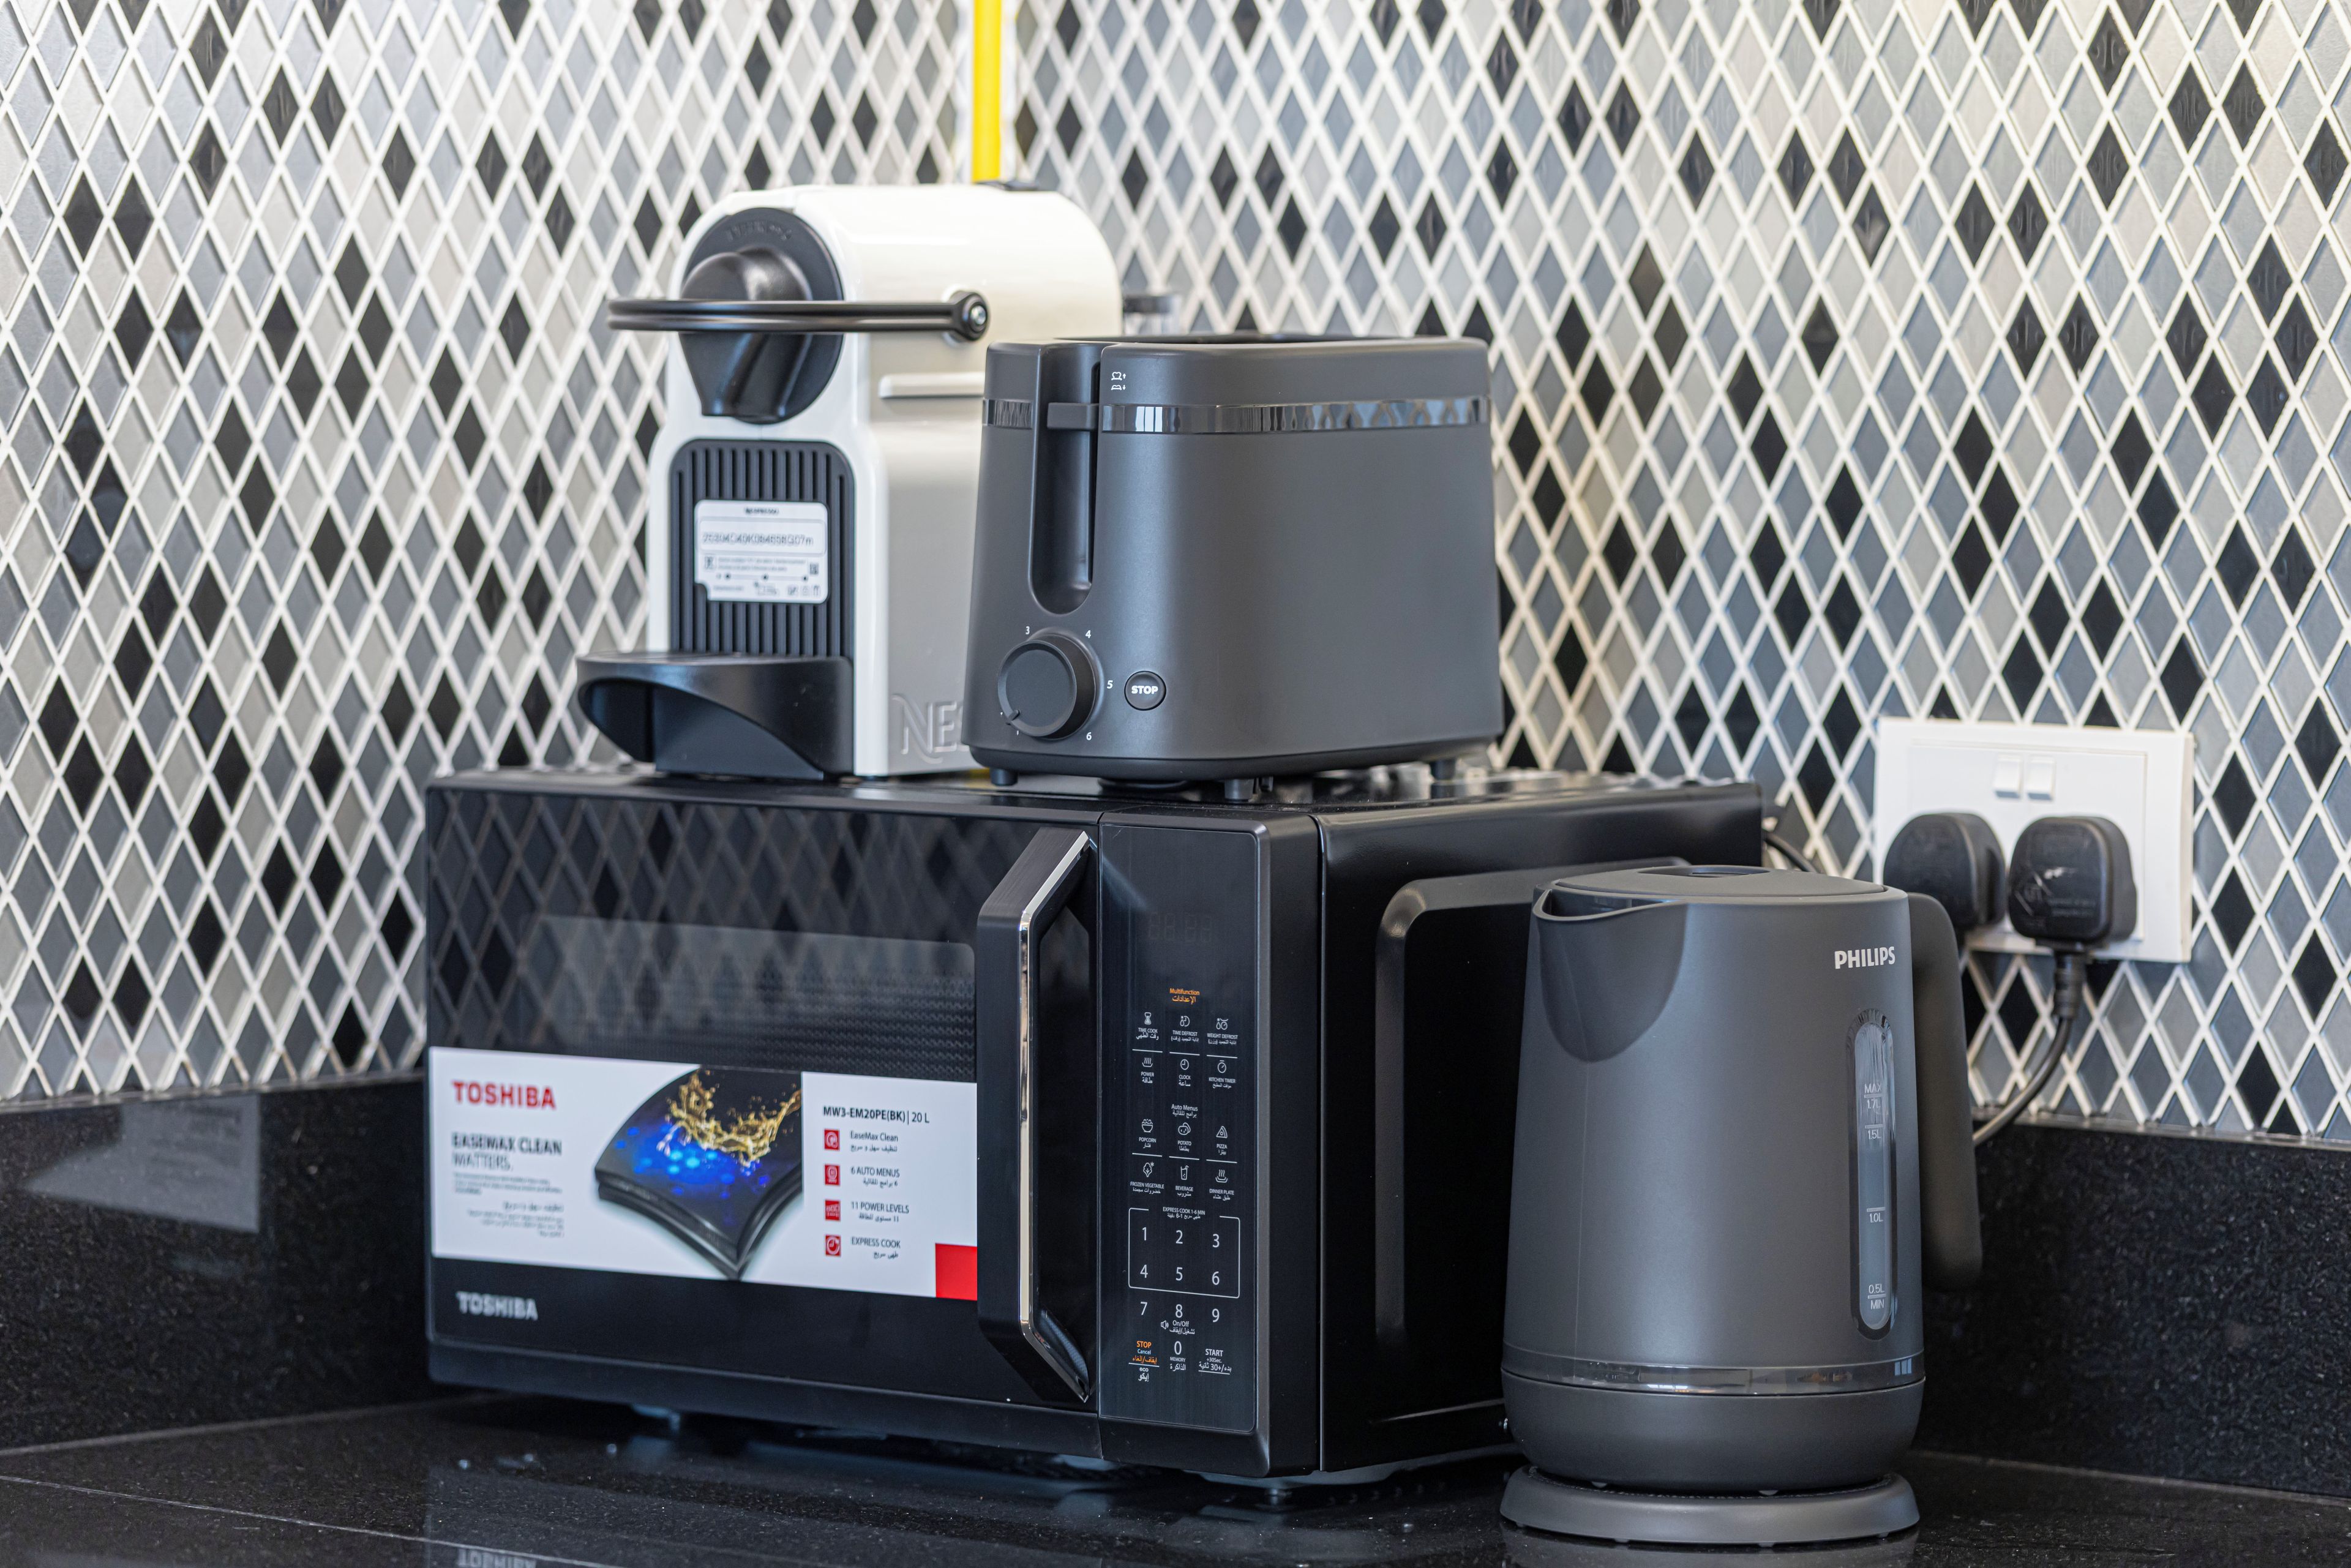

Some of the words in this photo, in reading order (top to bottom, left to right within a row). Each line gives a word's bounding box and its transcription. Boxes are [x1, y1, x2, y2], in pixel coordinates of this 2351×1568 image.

[1107, 680, 1113, 689] 5
[1834, 946, 1895, 969] PHILIPS
[1172, 996, 1196, 1004] الإعدادات
[1864, 1083, 1881, 1093] MAX
[452, 1081, 557, 1110] TOSHIBA
[1867, 1099, 1881, 1109] 1.7L
[912, 1111, 923, 1122] 20
[924, 1113, 929, 1123] L
[850, 1130, 878, 1141] EaseMax
[880, 1132, 898, 1142] Clean
[1868, 1130, 1881, 1139] 1.5L
[518, 1137, 563, 1155] CLEAN
[857, 1166, 875, 1176] AUTO
[876, 1168, 900, 1177] MENUS
[861, 1202, 884, 1212] POWER
[886, 1204, 910, 1214] LEVELS
[1869, 1213, 1883, 1223] 1.0L
[1142, 1227, 1147, 1241] 1
[1176, 1230, 1183, 1245] 2
[852, 1237, 879, 1247] EXPRESS
[881, 1239, 901, 1249] COOK
[1212, 1234, 1220, 1248] 3
[1140, 1264, 1148, 1278] 4
[1176, 1267, 1183, 1281] 5
[1212, 1271, 1220, 1285] 6
[1869, 1284, 1884, 1294] 0.5L
[456, 1291, 539, 1321] TOSHIBA
[1141, 1302, 1148, 1315] 7
[1175, 1304, 1183, 1318] 8
[1870, 1299, 1884, 1310] MIN
[1212, 1308, 1220, 1322] 9
[1174, 1341, 1182, 1355] 0
